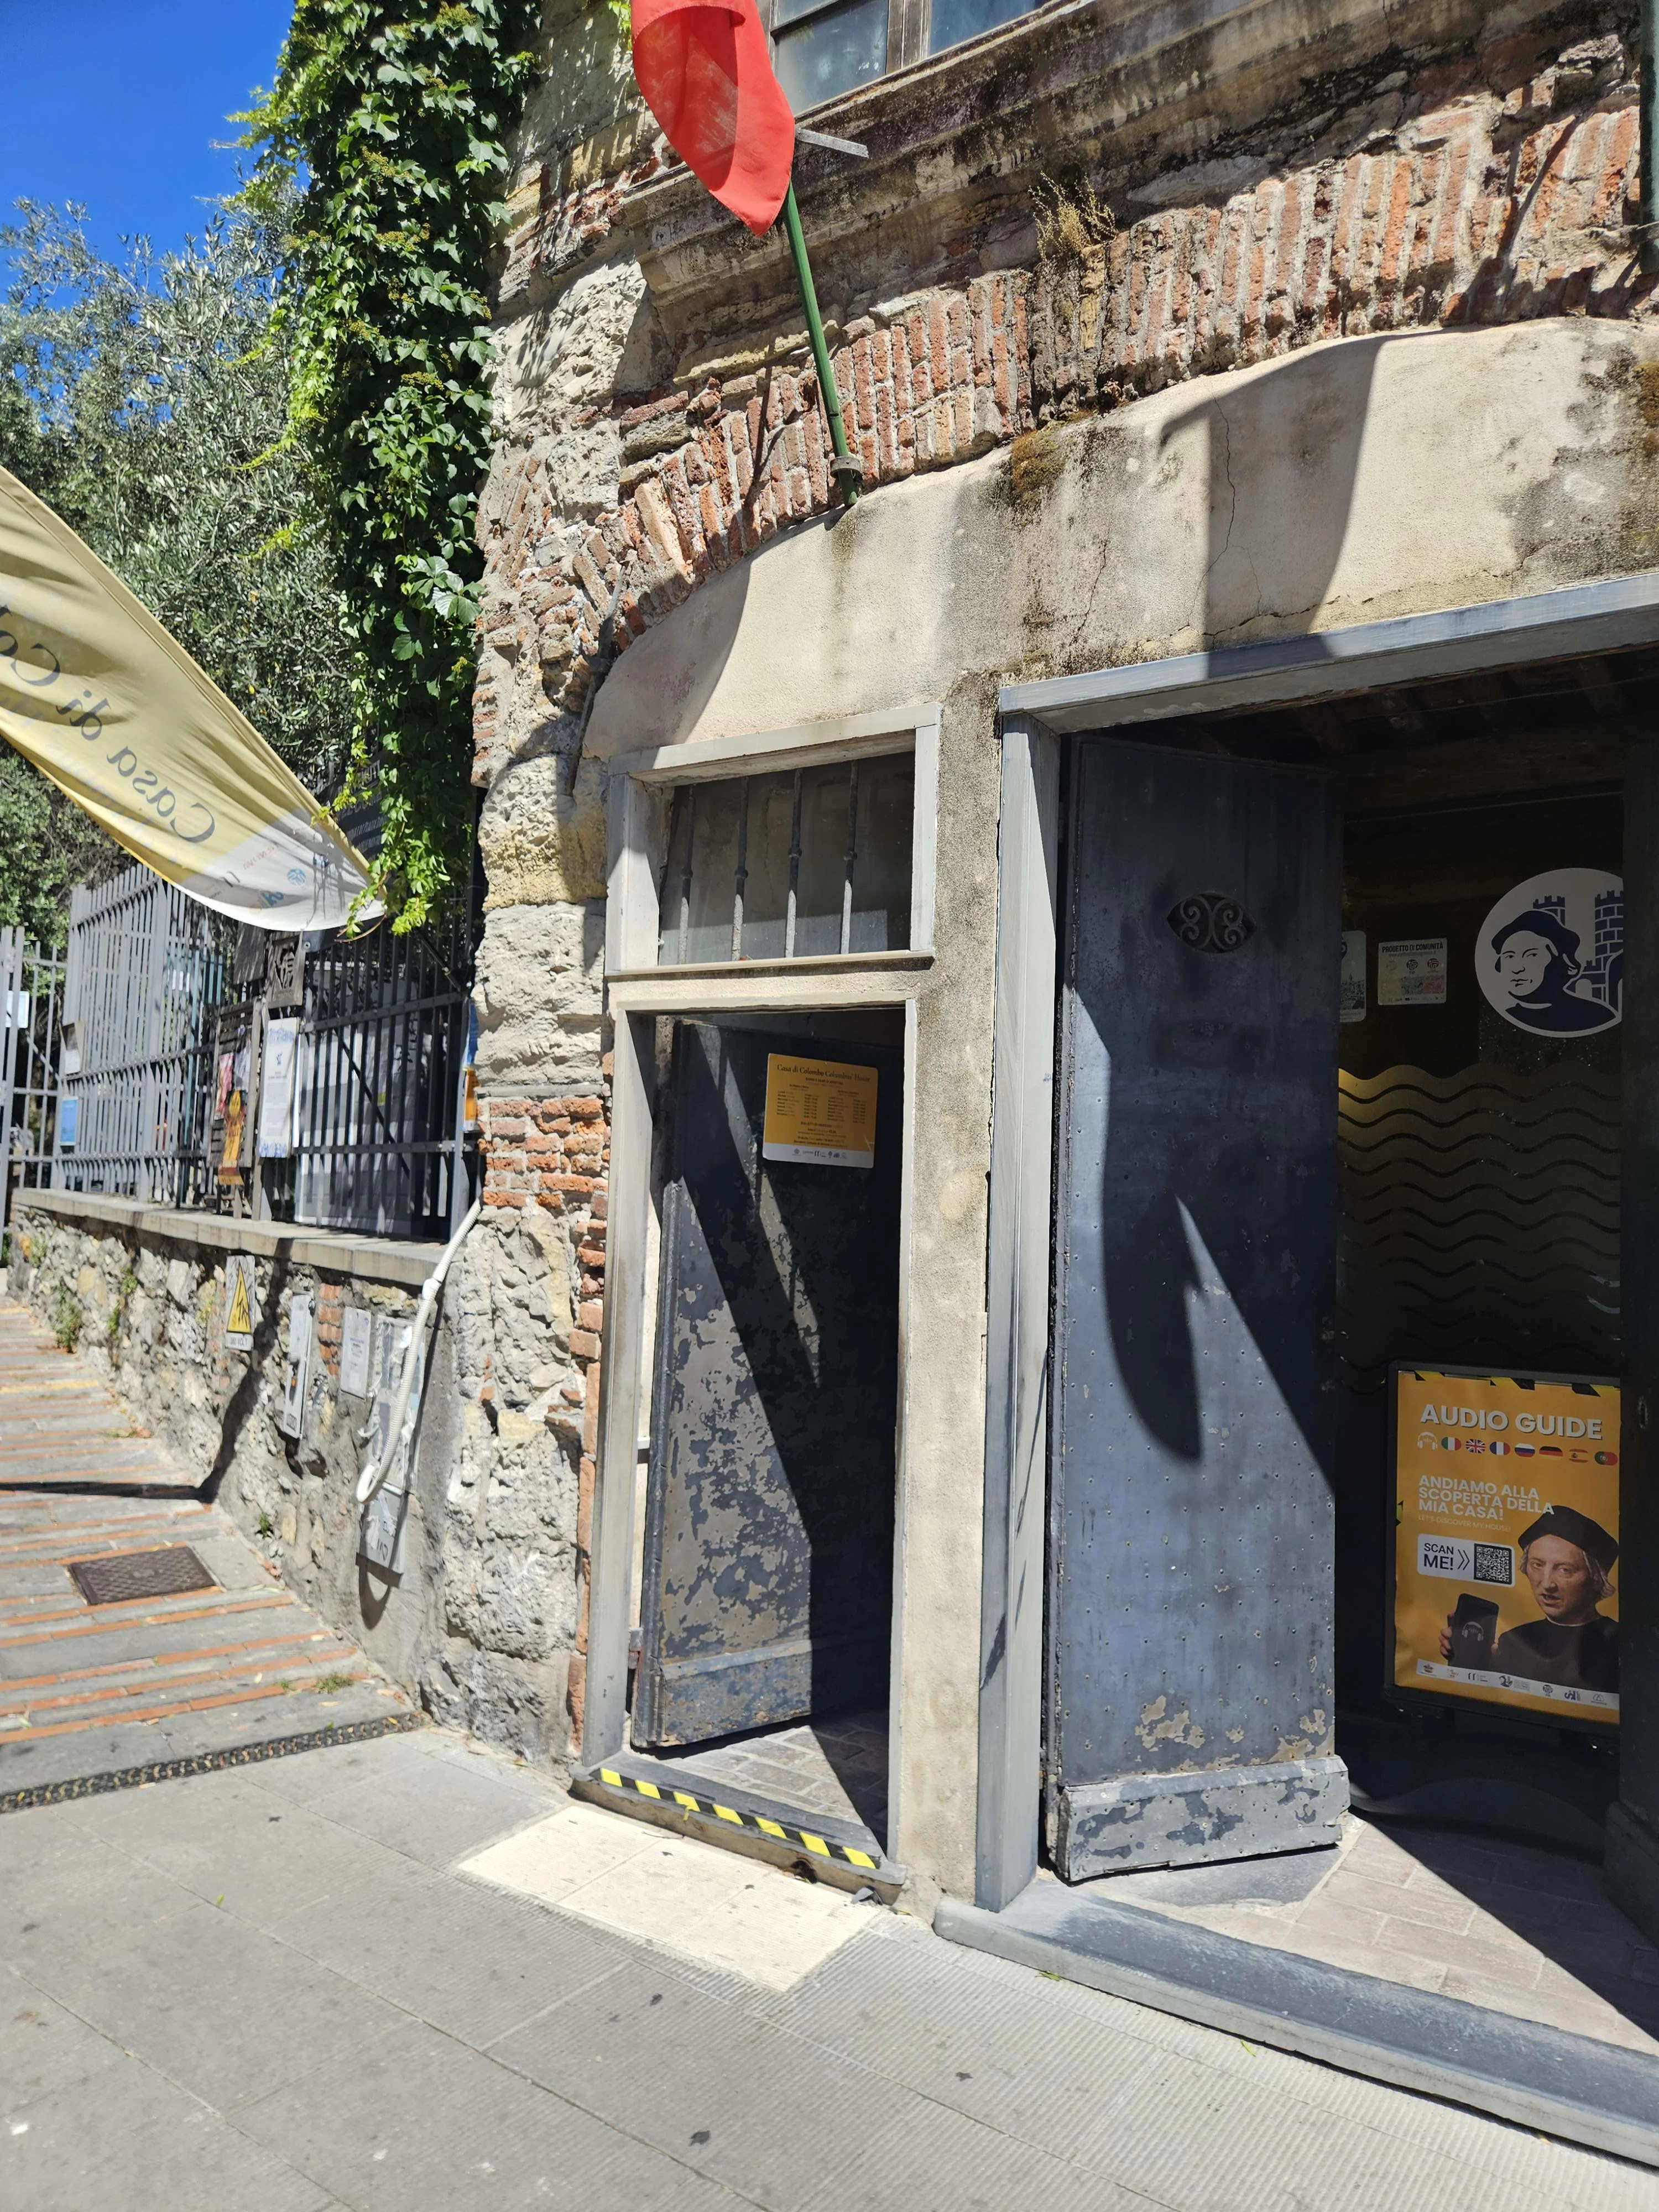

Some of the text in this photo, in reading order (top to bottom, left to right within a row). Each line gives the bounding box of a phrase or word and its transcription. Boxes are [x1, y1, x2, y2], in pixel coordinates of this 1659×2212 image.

[792, 1065, 798, 1073] di
[800, 1067, 824, 1076] Colombo
[1420, 1404, 1603, 1440] AUDIO GUIDE
[1418, 1475, 1539, 1500] ANDIAMO ALLA
[1418, 1486, 1554, 1515] SCOPERTA DELLA
[1419, 1499, 1504, 1520] MIA CASA!
[1437, 1516, 1472, 1527] DISCOVER
[1485, 1523, 1511, 1531] HOUSE!
[1424, 1543, 1454, 1555] SCAN
[1423, 1554, 1453, 1571] ME!
